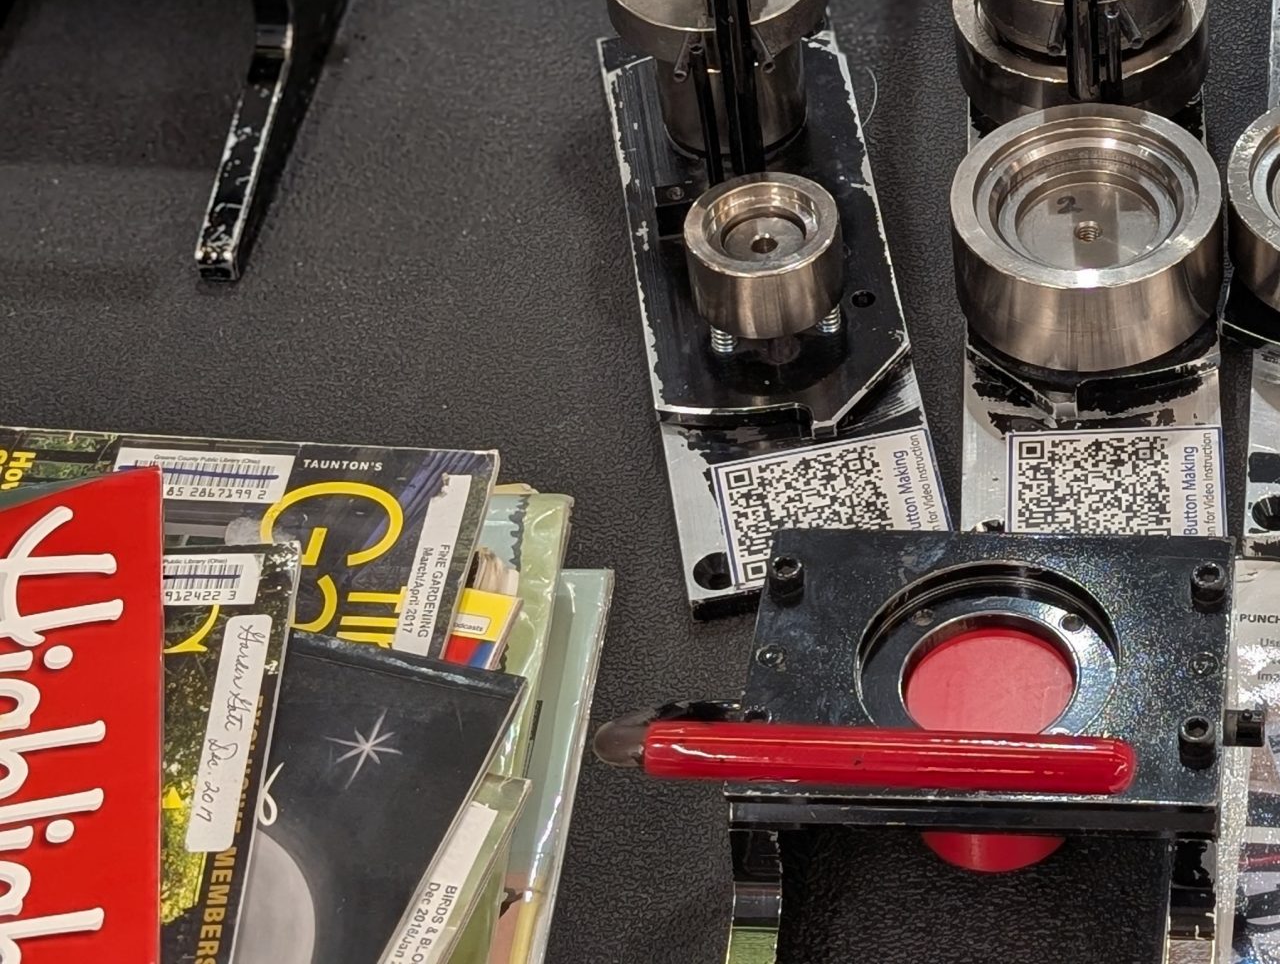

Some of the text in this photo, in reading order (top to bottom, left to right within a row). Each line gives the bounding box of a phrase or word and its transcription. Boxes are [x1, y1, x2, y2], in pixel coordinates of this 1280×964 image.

[1056, 195, 1083, 214] 2
[303, 458, 384, 471] TAUNTON'S
[910, 434, 928, 482] Instruction
[1201, 432, 1214, 481] Instruction
[893, 450, 922, 531] utton Making
[921, 483, 936, 510] Video
[1181, 446, 1198, 536] Button Making
[1203, 483, 1215, 510] Video
[927, 510, 940, 523] for
[1204, 511, 1216, 524] for
[417, 543, 451, 638] FINE GARDENING
[402, 606, 418, 634] 2017
[421, 881, 441, 905] Dec
[431, 885, 458, 924] BIRDS
